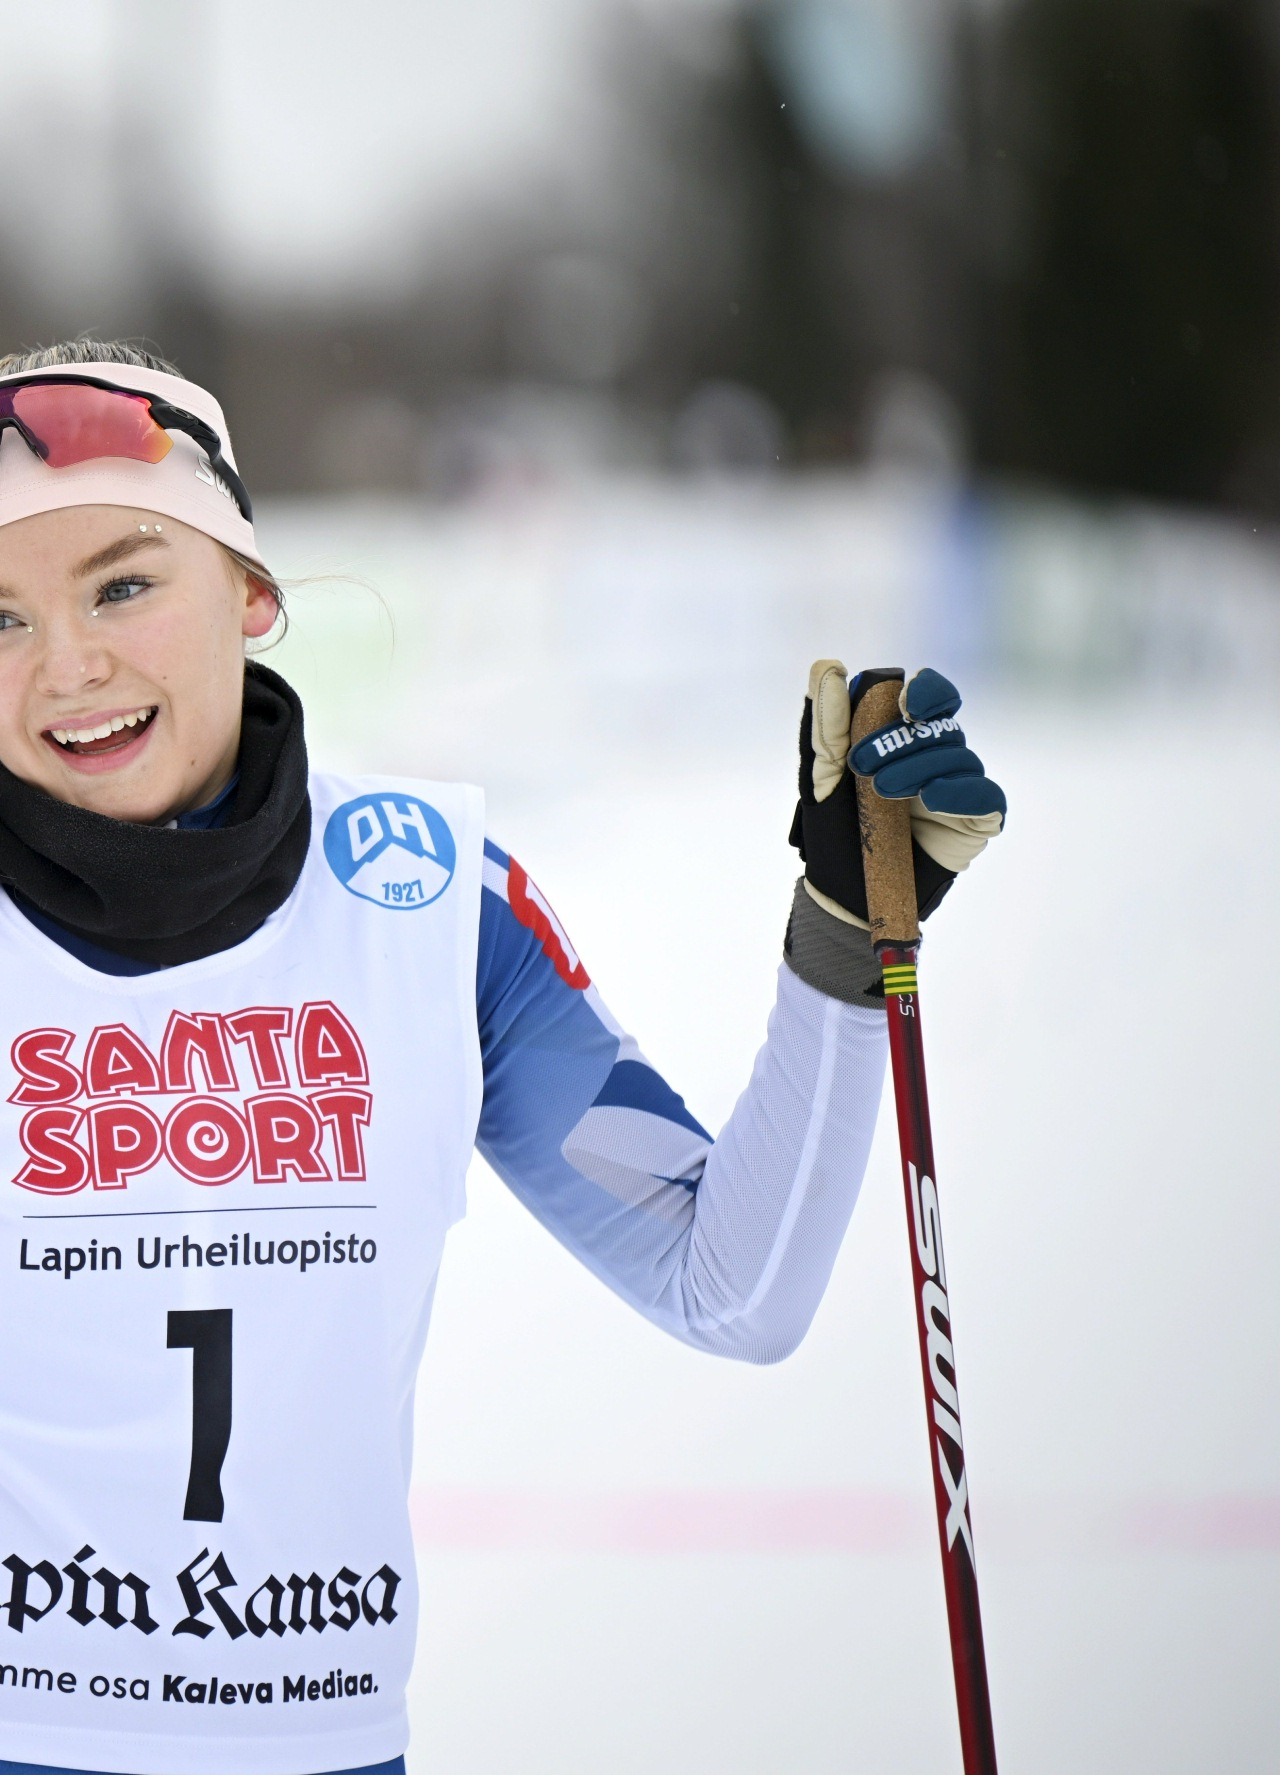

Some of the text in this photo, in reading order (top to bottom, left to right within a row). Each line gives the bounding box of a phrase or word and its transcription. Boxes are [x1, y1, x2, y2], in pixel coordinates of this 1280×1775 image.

[382, 879, 424, 902] 1927
[7, 1001, 370, 1105] SANTA
[11, 1088, 372, 1195] SPORT
[20, 1232, 377, 1279] Lapin Urheiluopisto
[166, 1308, 233, 1523] 1
[172, 1547, 402, 1641] Kansa
[89, 1676, 150, 1701] osa
[162, 1675, 273, 1704] Kaleva
[283, 1669, 379, 1702] Mediaa.
